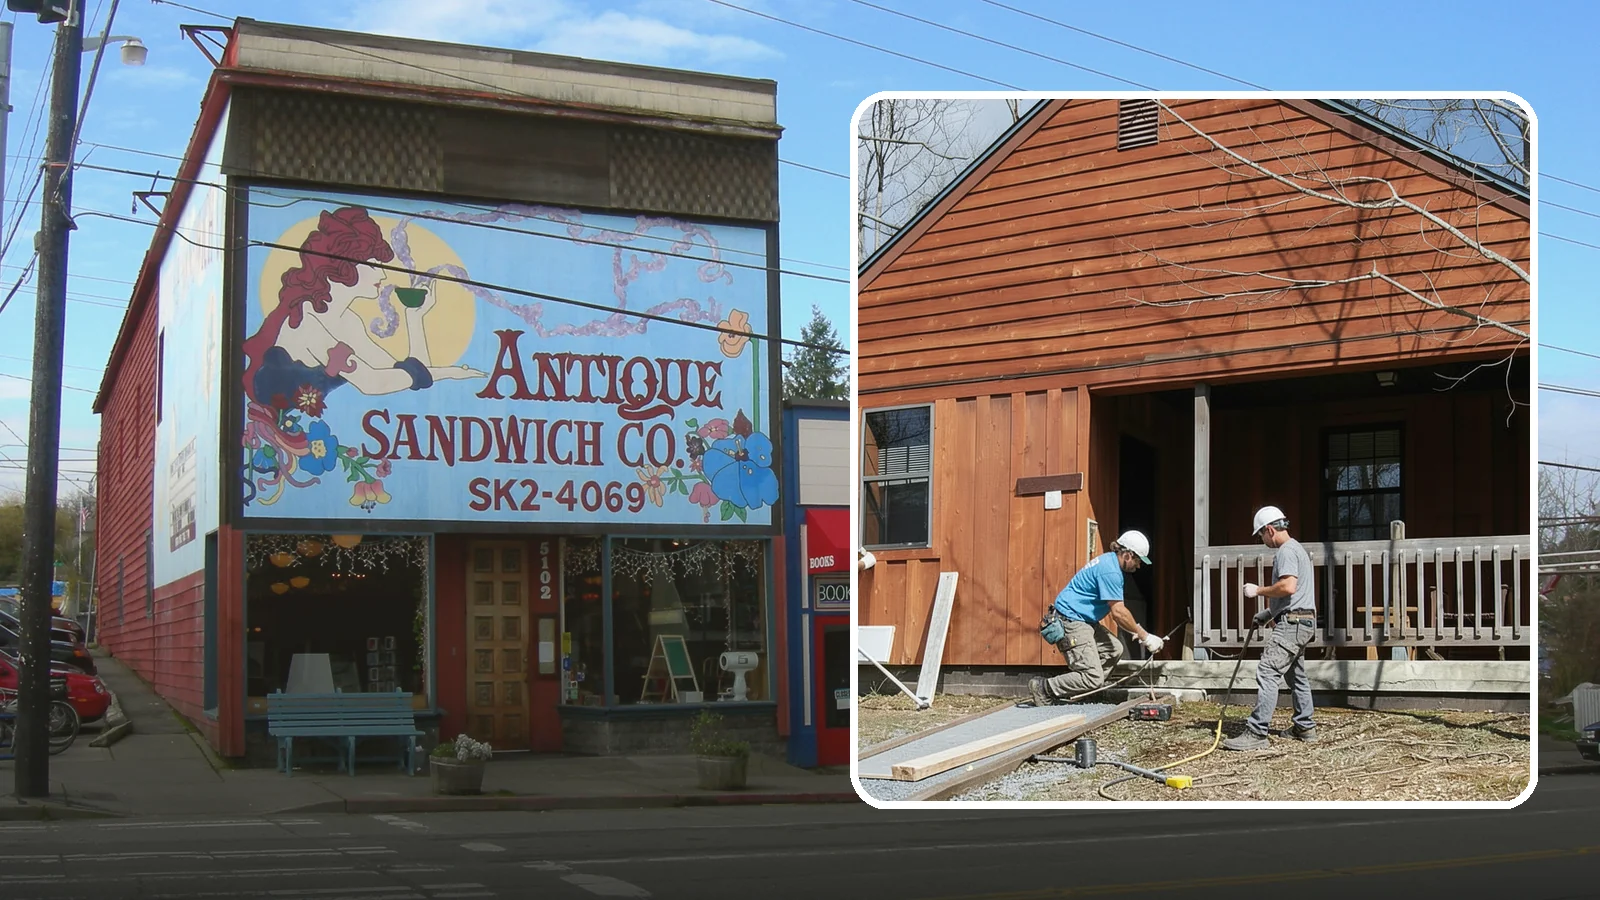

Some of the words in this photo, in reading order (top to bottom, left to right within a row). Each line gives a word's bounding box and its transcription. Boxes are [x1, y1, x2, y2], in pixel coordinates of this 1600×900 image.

[476, 329, 723, 421] ANTIQUE
[361, 408, 604, 467] SANDWICH
[617, 422, 685, 469] CO.
[468, 477, 645, 513] SK2-4069
[540, 542, 551, 599] 5102
[809, 555, 834, 568] BOOKS
